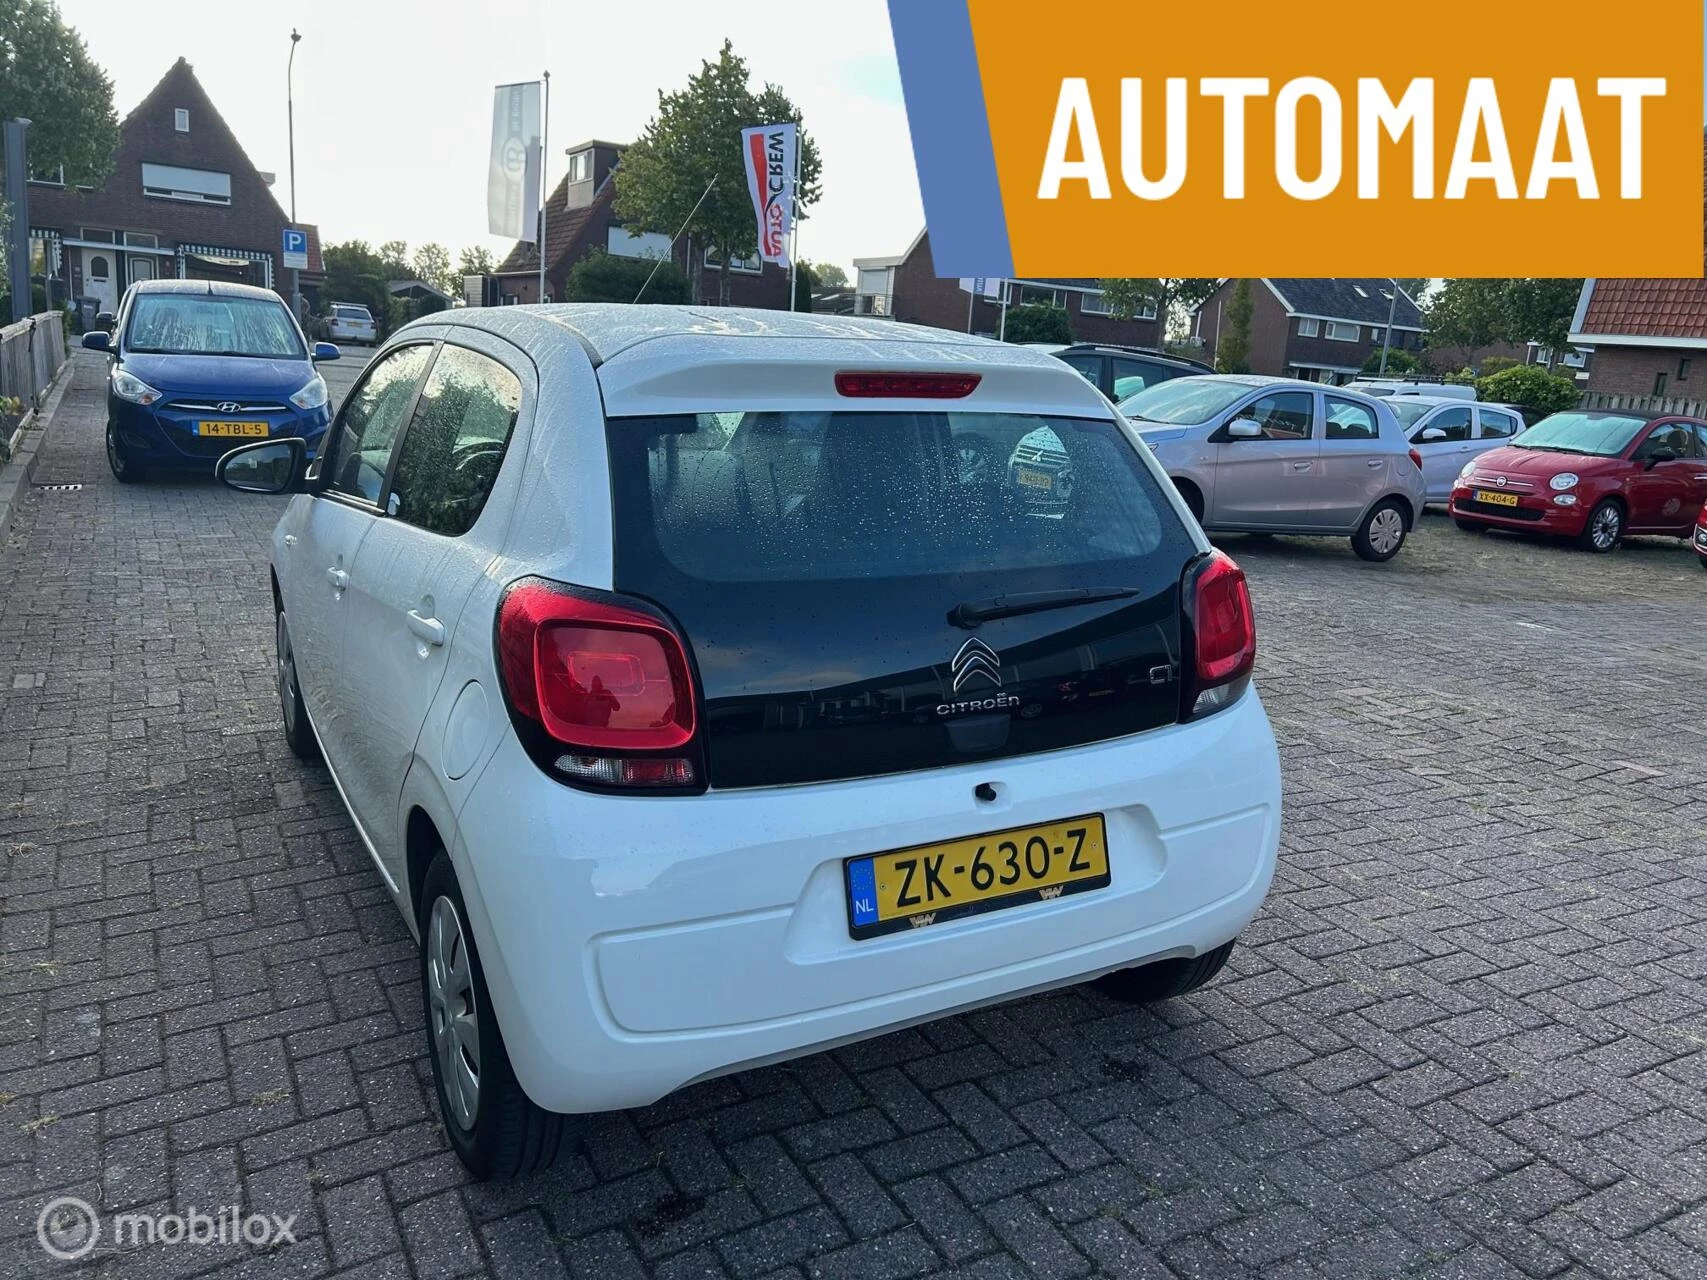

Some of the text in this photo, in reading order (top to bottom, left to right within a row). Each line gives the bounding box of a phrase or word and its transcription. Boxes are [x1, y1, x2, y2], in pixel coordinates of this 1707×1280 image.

[289, 233, 302, 250] P
[206, 423, 262, 435] 14-TBL-5
[1480, 492, 1515, 505] XX-404-G
[894, 827, 1091, 909] ZK-630-Z
[854, 897, 874, 915] NL
